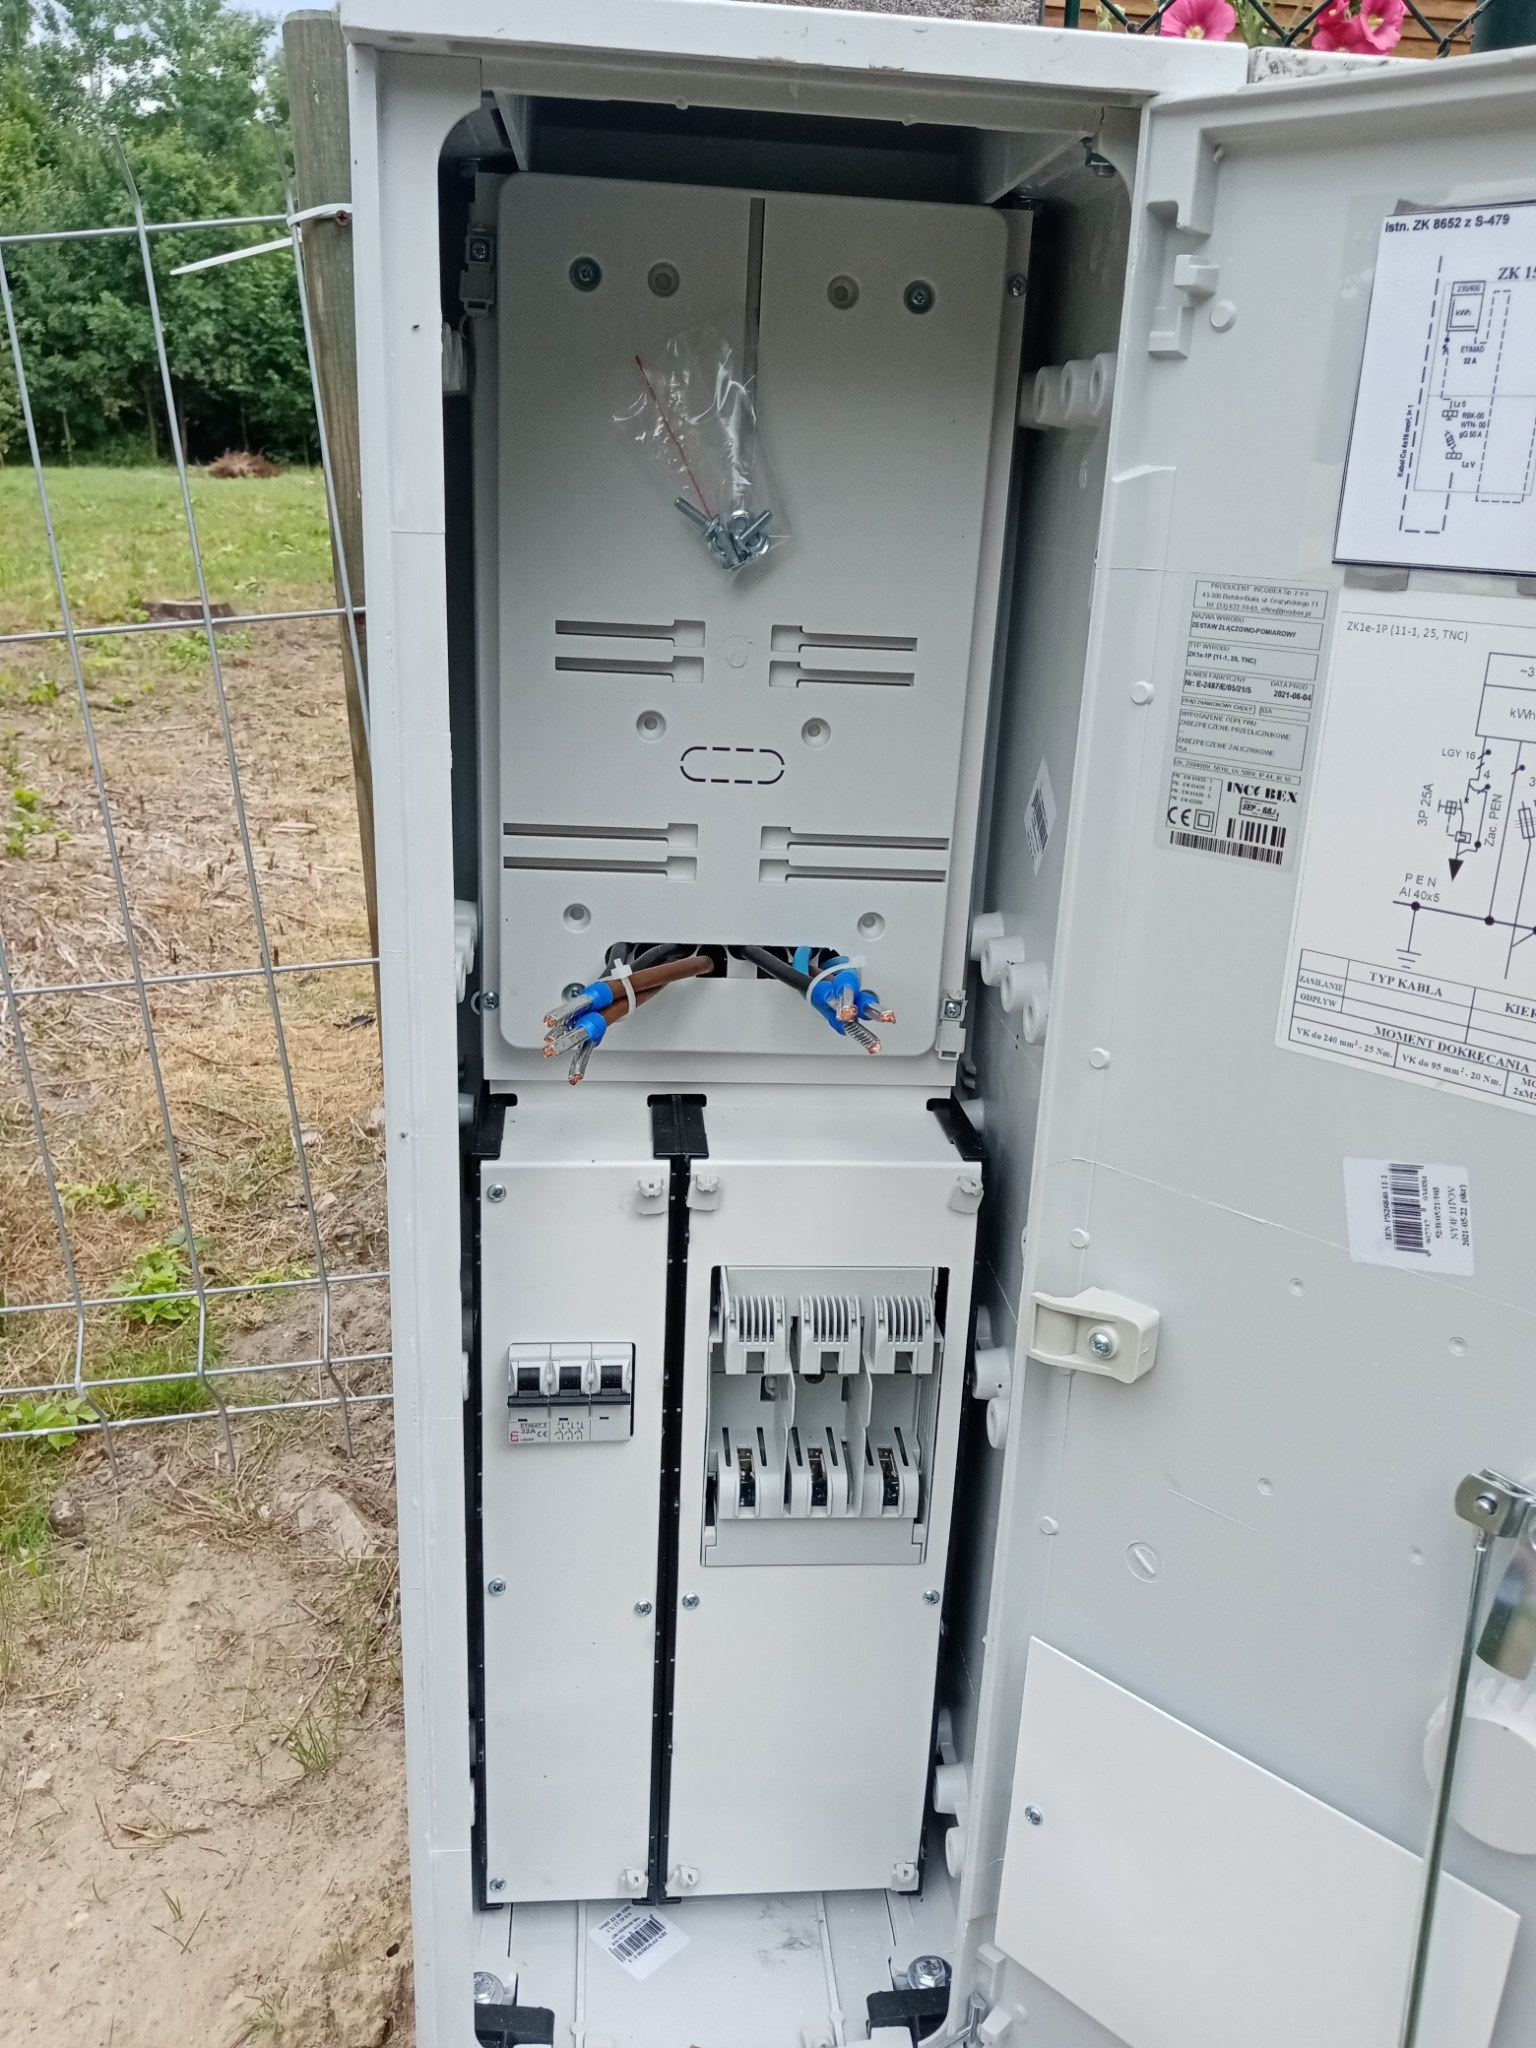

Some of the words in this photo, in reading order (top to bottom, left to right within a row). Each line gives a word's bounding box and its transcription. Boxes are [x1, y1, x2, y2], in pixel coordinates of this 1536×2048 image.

[1385, 221, 1409, 232] Istn.
[1413, 219, 1430, 231] ZK
[1433, 217, 1461, 229] 8652
[1464, 218, 1471, 228] z
[1475, 214, 1510, 227] S-479
[1498, 266, 1521, 280] ZK
[1400, 450, 1407, 459] Cu
[1211, 582, 1250, 591] PRODUCENT
[1253, 585, 1281, 594] INCOBEX
[1216, 614, 1244, 623] WYROBU
[1192, 622, 1218, 631] ZESTAW
[1218, 625, 1297, 638] ZŁĄCZOWO-POMIAROWY
[1347, 621, 1388, 634] ZK1e-1P
[1390, 625, 1420, 639] (11-1,
[1423, 628, 1439, 640] 25,
[1443, 630, 1468, 642] TNC)
[1190, 641, 1202, 649] TYP
[1202, 643, 1230, 651] WYROBU
[1241, 656, 1257, 665] TNC)
[1274, 690, 1312, 702] 2021-06-04
[1231, 726, 1290, 740] PRZEDLICZNIKOWE
[1228, 743, 1274, 756] ZALICZNIKOWE
[1441, 748, 1461, 758] LGY
[1465, 751, 1476, 760] 16
[1483, 770, 1491, 779] 4
[1421, 783, 1434, 807] 25A
[1489, 794, 1502, 819] PEN
[1417, 812, 1428, 827] 3P
[1413, 889, 1440, 902] 40x5
[1299, 975, 1344, 992] ZASILANIE
[1369, 971, 1395, 986] TYP
[1397, 978, 1443, 997] KABLA
[1297, 1027, 1312, 1037] VK
[1324, 1034, 1337, 1044] 240
[1364, 1045, 1374, 1053] 25
[1374, 1026, 1435, 1049] MOMENT
[1437, 1041, 1530, 1073] DOKRĘCANIA
[1402, 1053, 1416, 1064] VK
[1418, 1059, 1429, 1067] do
[1431, 1061, 1441, 1070] 95
[1470, 1071, 1481, 1080] 20
